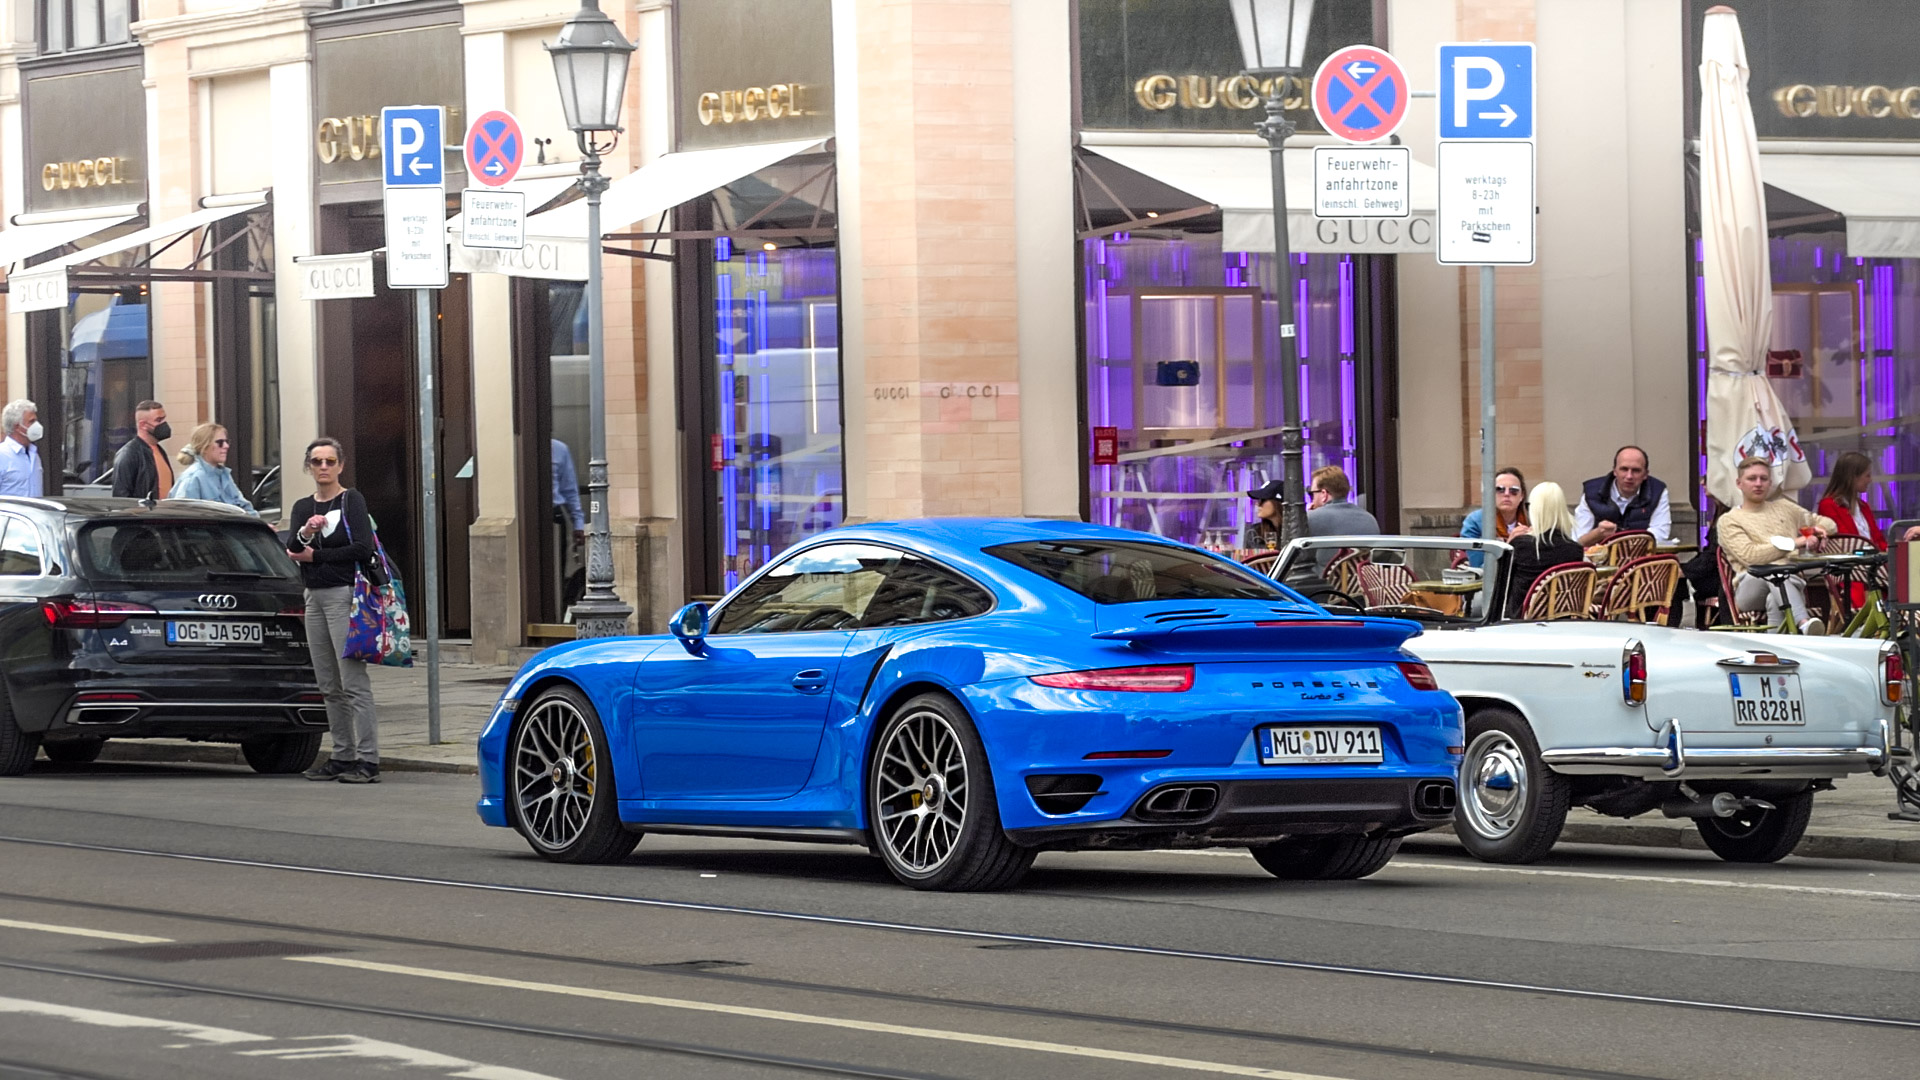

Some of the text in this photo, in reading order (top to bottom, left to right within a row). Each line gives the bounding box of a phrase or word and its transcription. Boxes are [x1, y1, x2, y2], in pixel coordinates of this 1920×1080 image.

[1454, 57, 1505, 127] P
[698, 83, 803, 126] GUCCI
[392, 118, 425, 176] P
[1327, 156, 1399, 171] Feuerwehr-
[42, 157, 124, 191] GUCCI
[1465, 175, 1507, 187] werktags
[1326, 177, 1399, 191] anfahrtzone
[1472, 189, 1500, 200] 8-23h
[471, 198, 518, 210] Feuerwehr-
[1479, 206, 1493, 215] mit
[470, 215, 517, 227] anfahrtzone
[1461, 220, 1511, 231] Parkschein
[310, 267, 362, 291] GUCCI
[874, 386, 910, 400] GUCCI
[178, 623, 261, 641] OG JA 590
[109, 637, 128, 646] A4
[1251, 681, 1379, 689] PORSCHE
[1760, 676, 1773, 698] M
[1333, 692, 1345, 701] S
[1737, 699, 1802, 721] RR 828 H
[1273, 730, 1380, 755] MÜ DV 911
